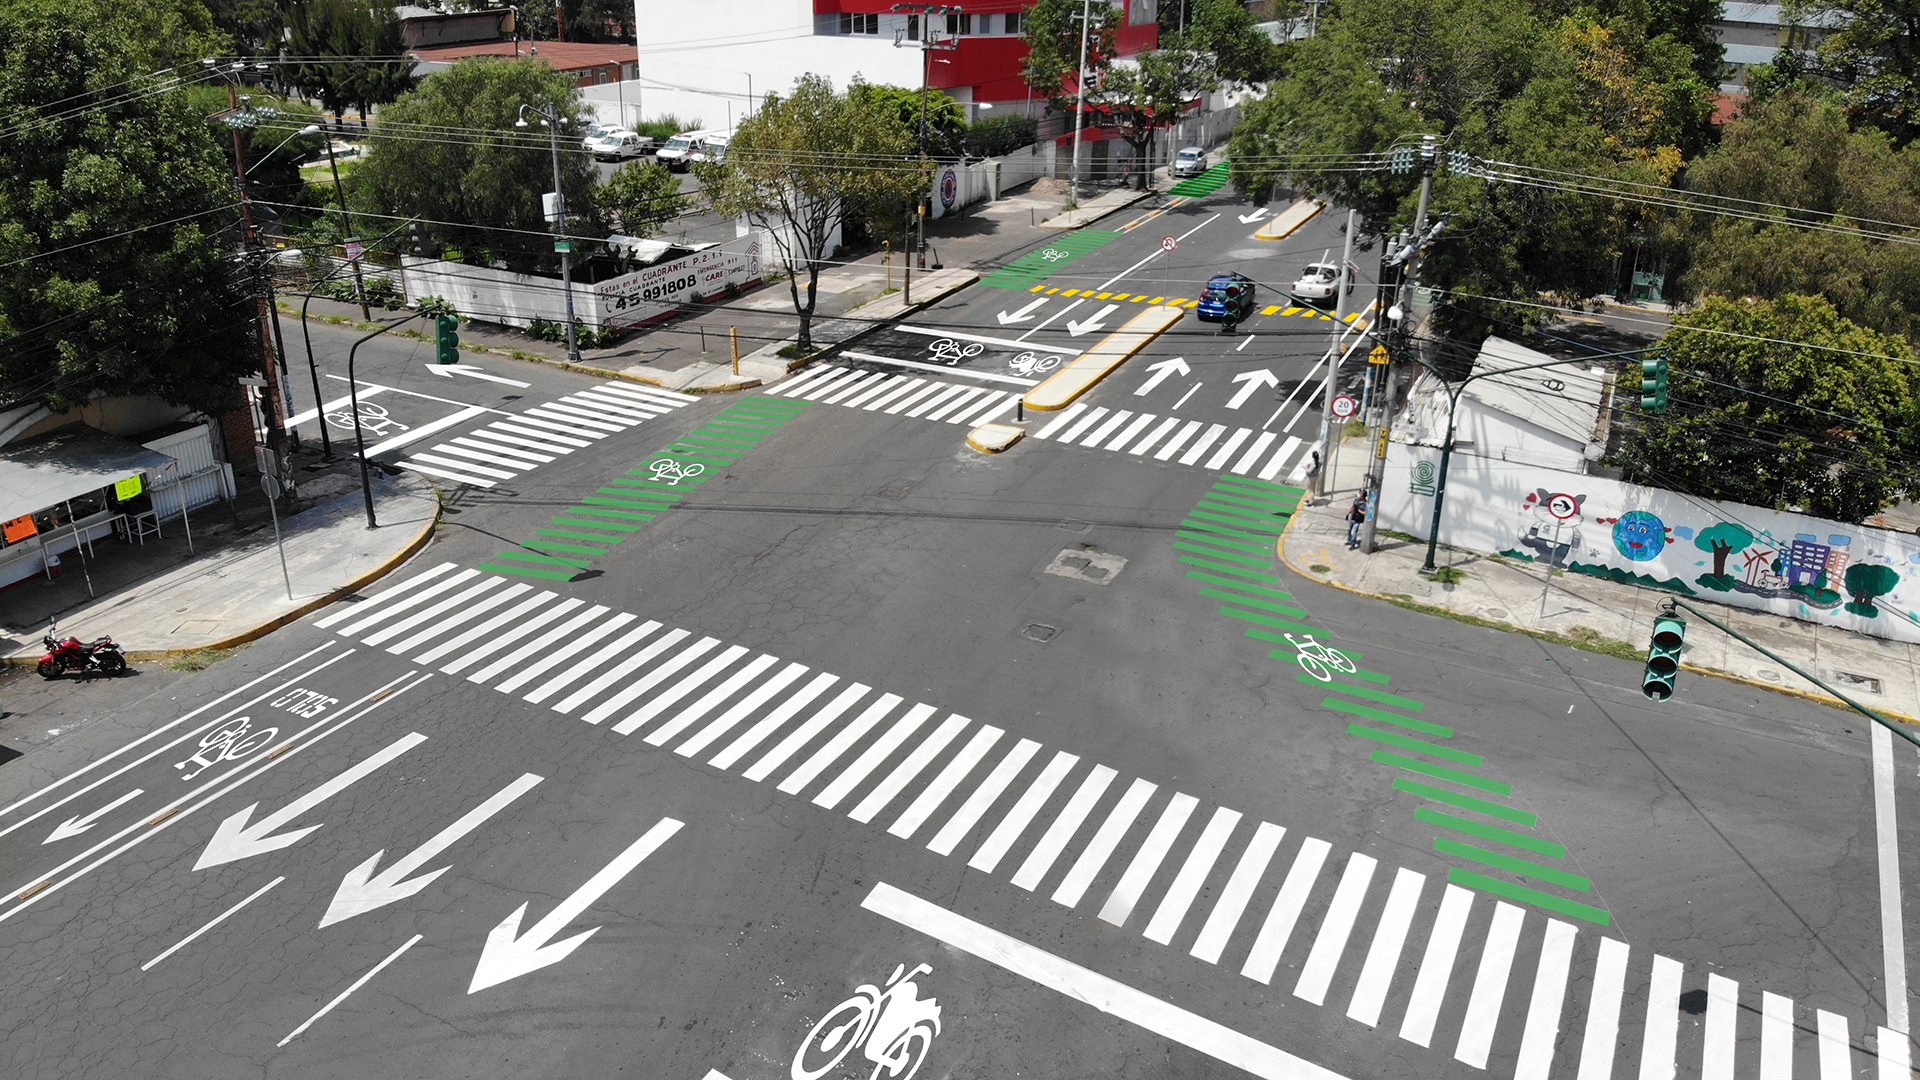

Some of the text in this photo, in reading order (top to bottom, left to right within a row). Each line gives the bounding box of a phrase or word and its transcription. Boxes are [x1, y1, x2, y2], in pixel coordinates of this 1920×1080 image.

[622, 280, 631, 288] en
[632, 276, 638, 284] el
[642, 261, 687, 281] CUADRANTE
[706, 271, 723, 281] CARE
[629, 277, 666, 293] CUADRANTE
[1338, 400, 1349, 408] 20
[270, 688, 339, 719] SOLO
